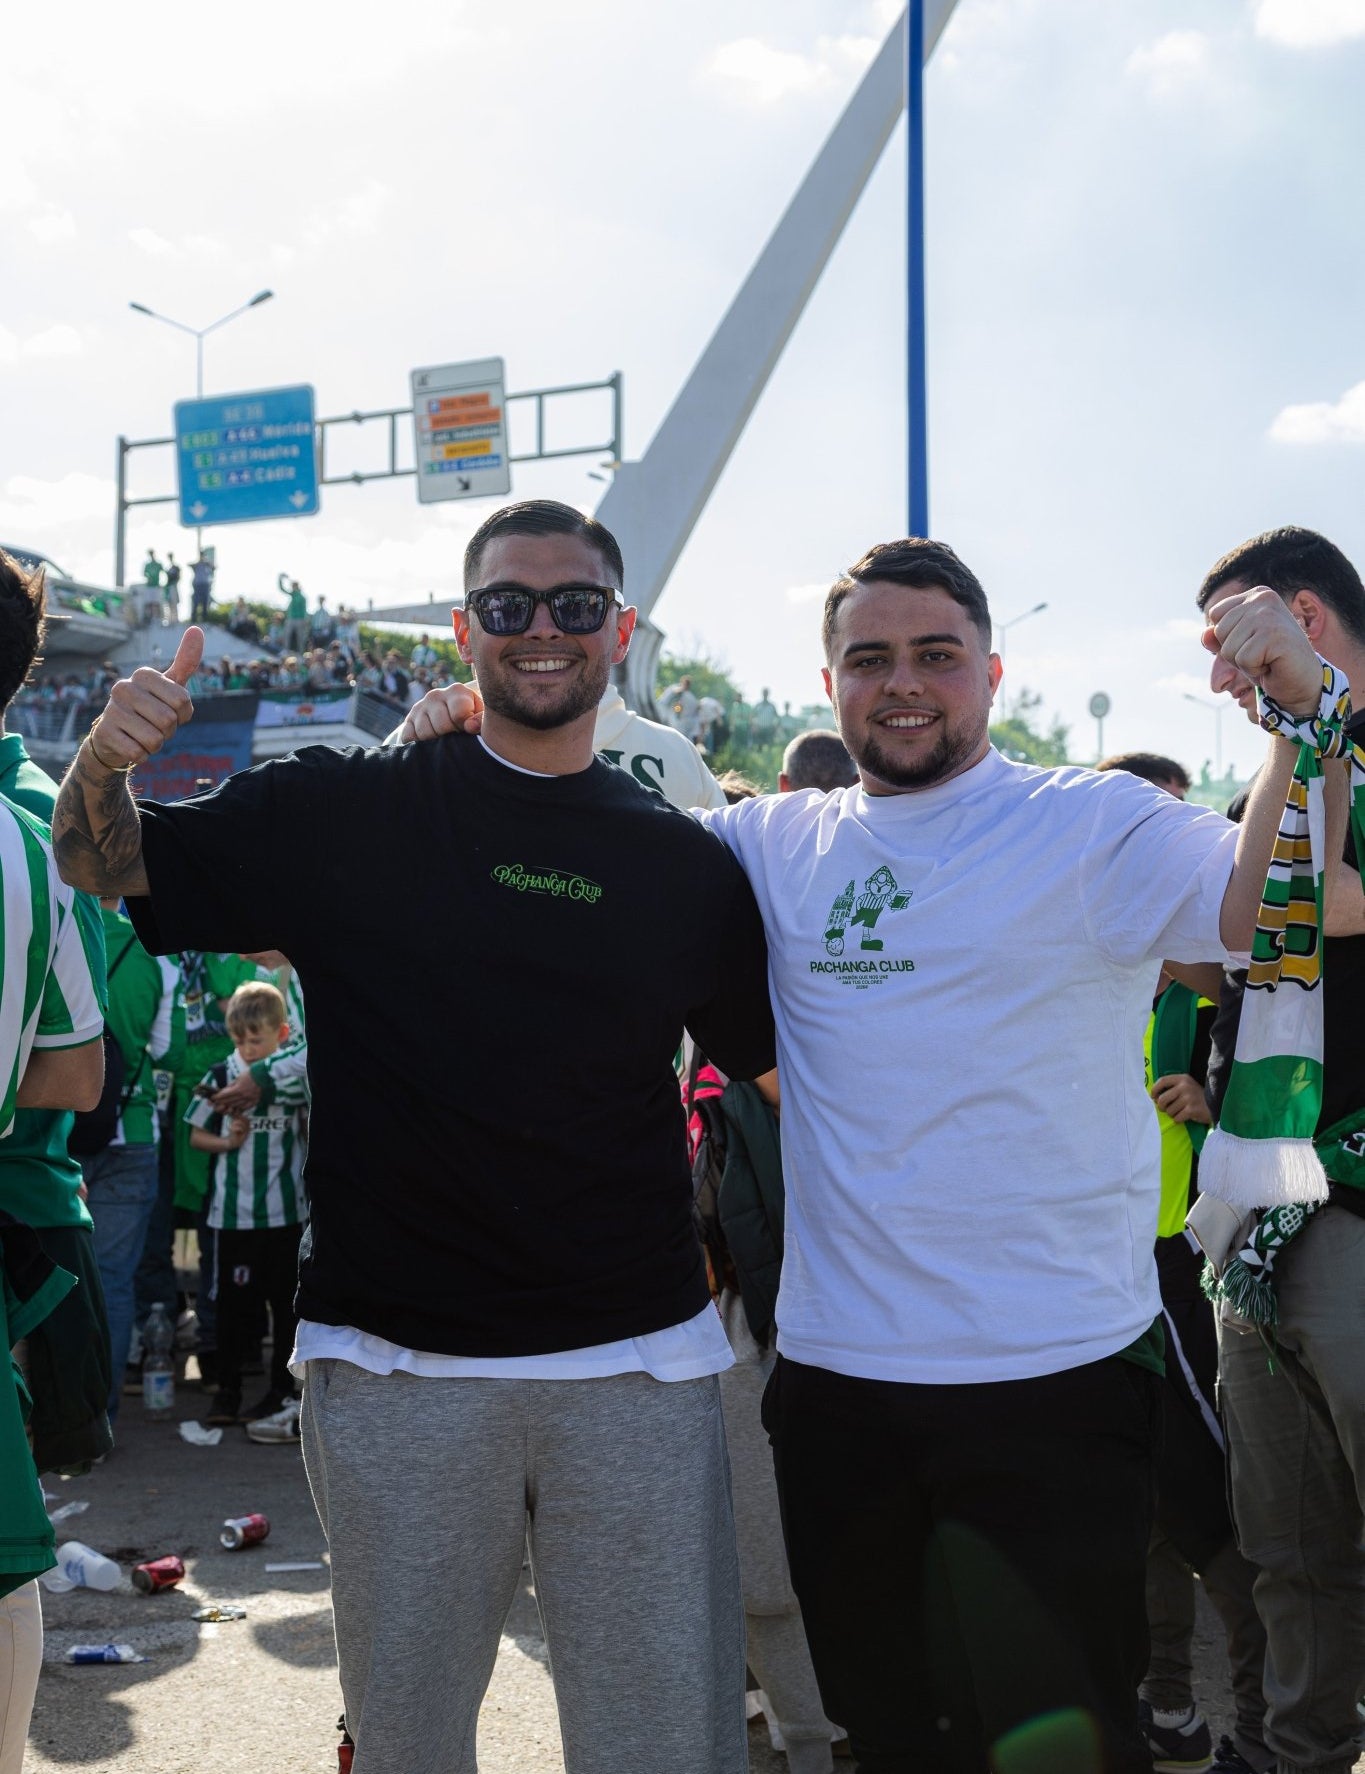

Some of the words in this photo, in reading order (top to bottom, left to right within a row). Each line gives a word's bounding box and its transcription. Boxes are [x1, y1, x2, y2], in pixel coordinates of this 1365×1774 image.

[494, 863, 567, 896] PACHANGA
[568, 877, 603, 904] CLUB
[810, 961, 878, 973] PACHANGA
[879, 960, 915, 972] CLUB
